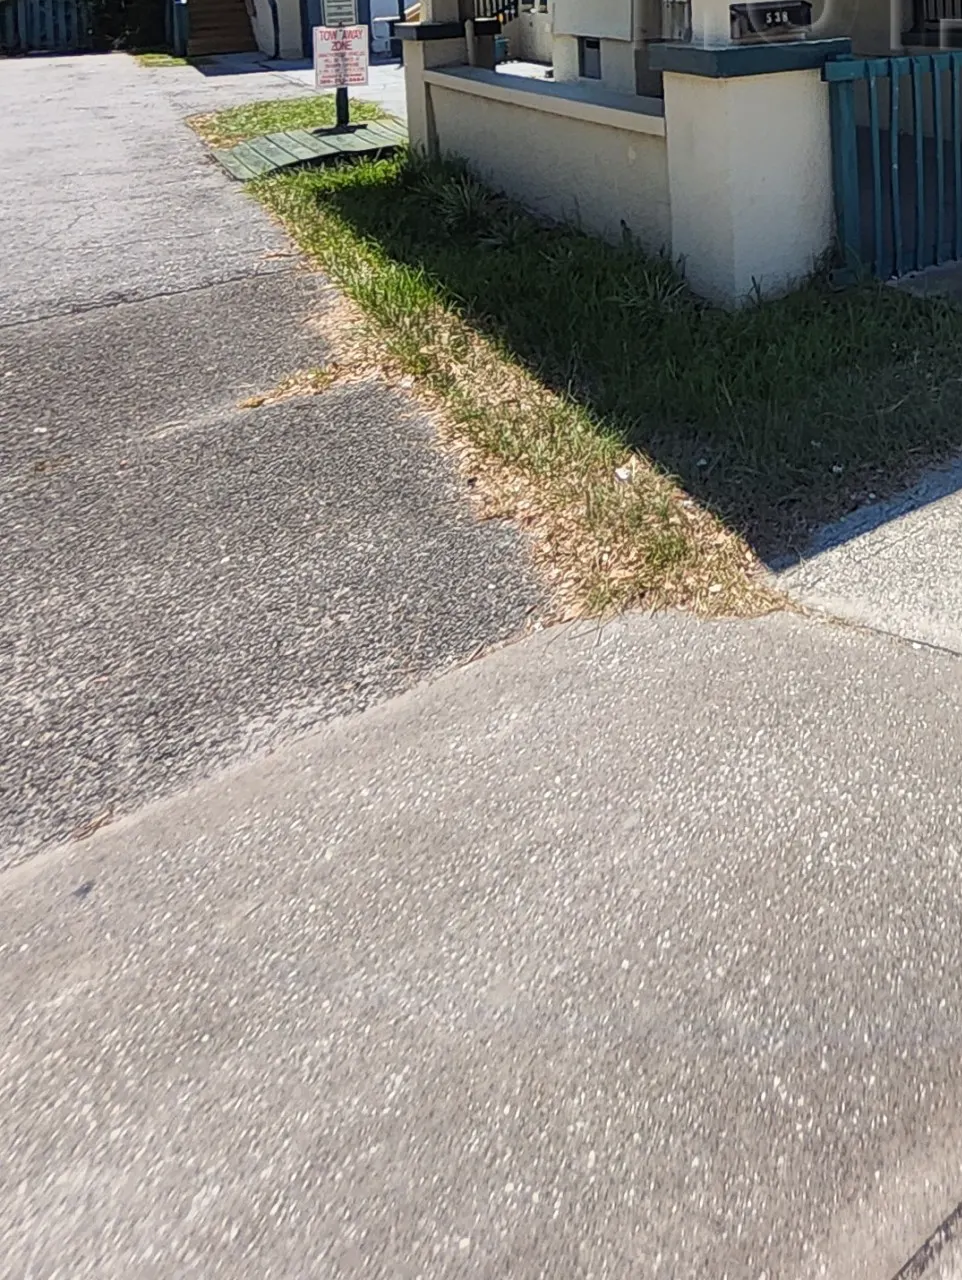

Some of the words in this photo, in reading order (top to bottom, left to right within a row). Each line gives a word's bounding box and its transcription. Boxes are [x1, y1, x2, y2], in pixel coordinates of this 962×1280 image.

[766, 11, 788, 24] 538
[319, 30, 338, 41] TOW
[342, 29, 363, 40] AWAY
[331, 40, 352, 51] ZONE
